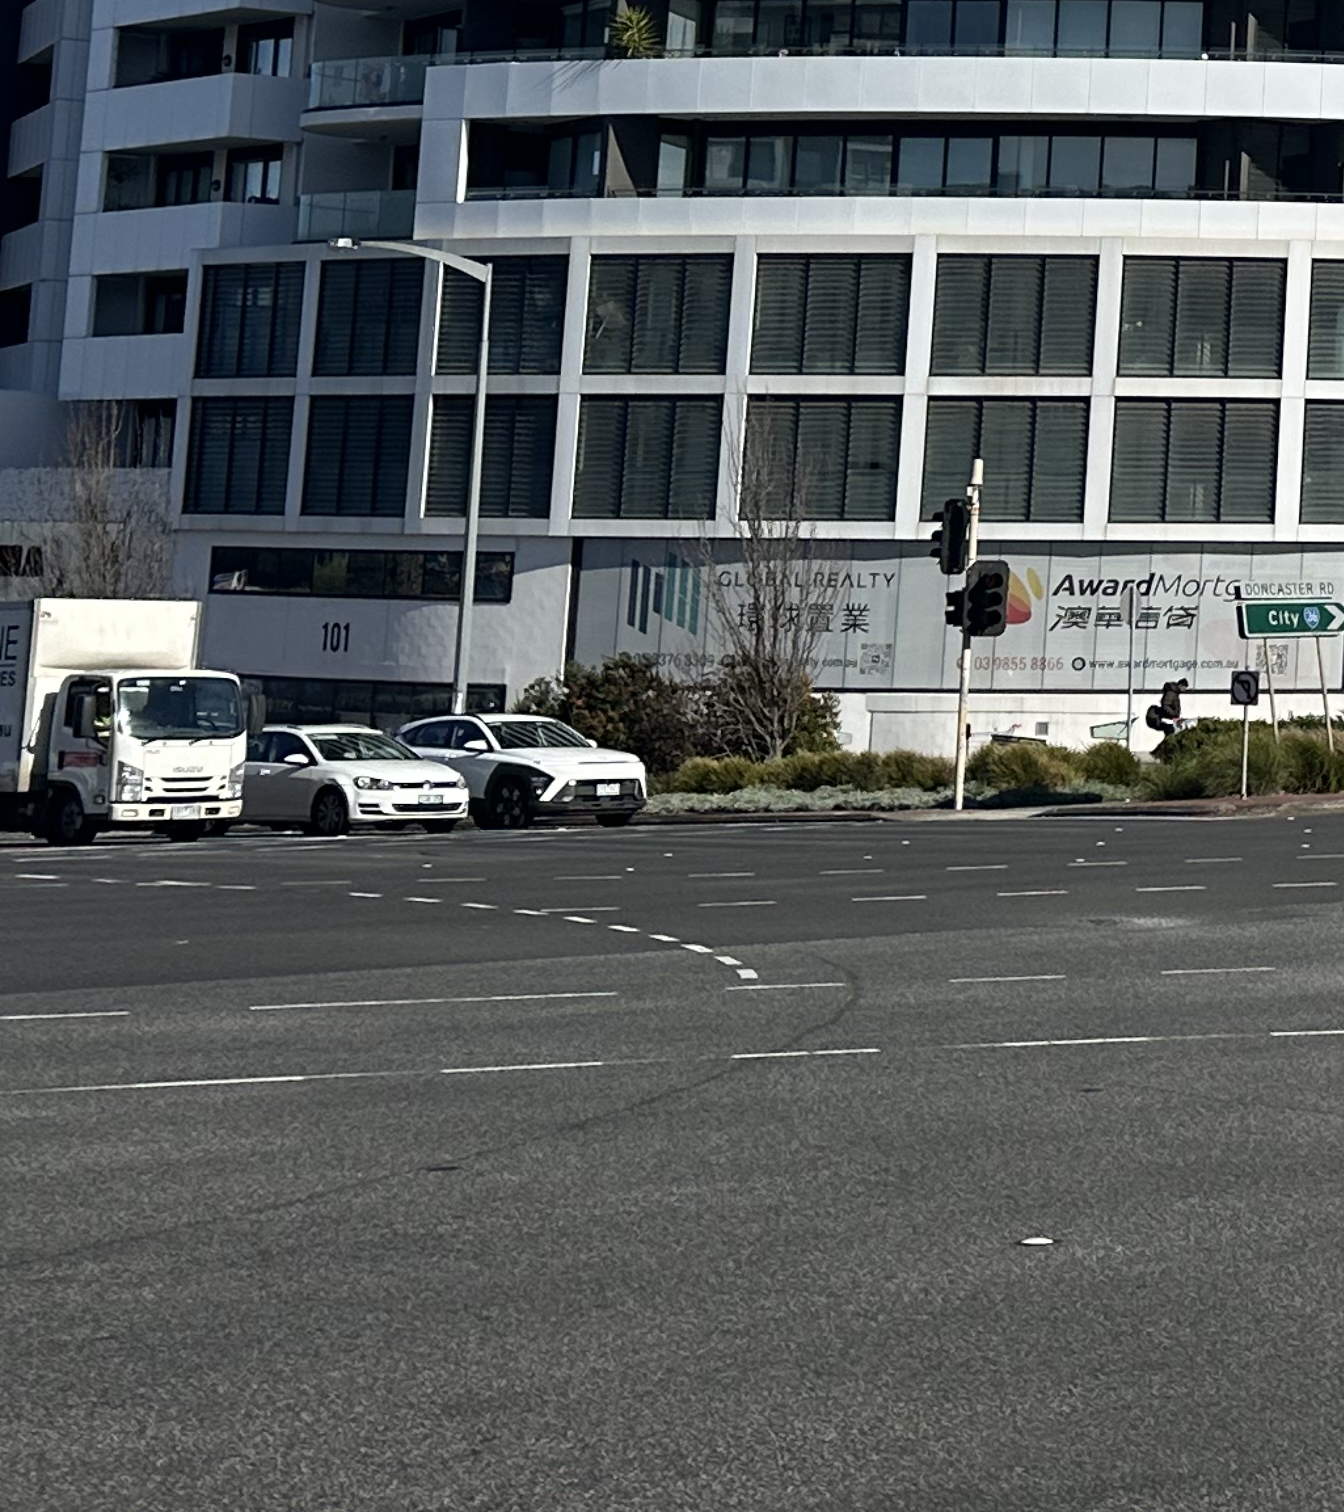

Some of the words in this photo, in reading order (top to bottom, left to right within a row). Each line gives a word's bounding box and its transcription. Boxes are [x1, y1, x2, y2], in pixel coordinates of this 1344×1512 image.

[813, 572, 895, 588] REALTY
[1244, 582, 1314, 596] DONCASTER
[1319, 581, 1334, 595] RD
[1268, 610, 1299, 629] City
[322, 622, 350, 652] 101
[974, 656, 991, 670] 03
